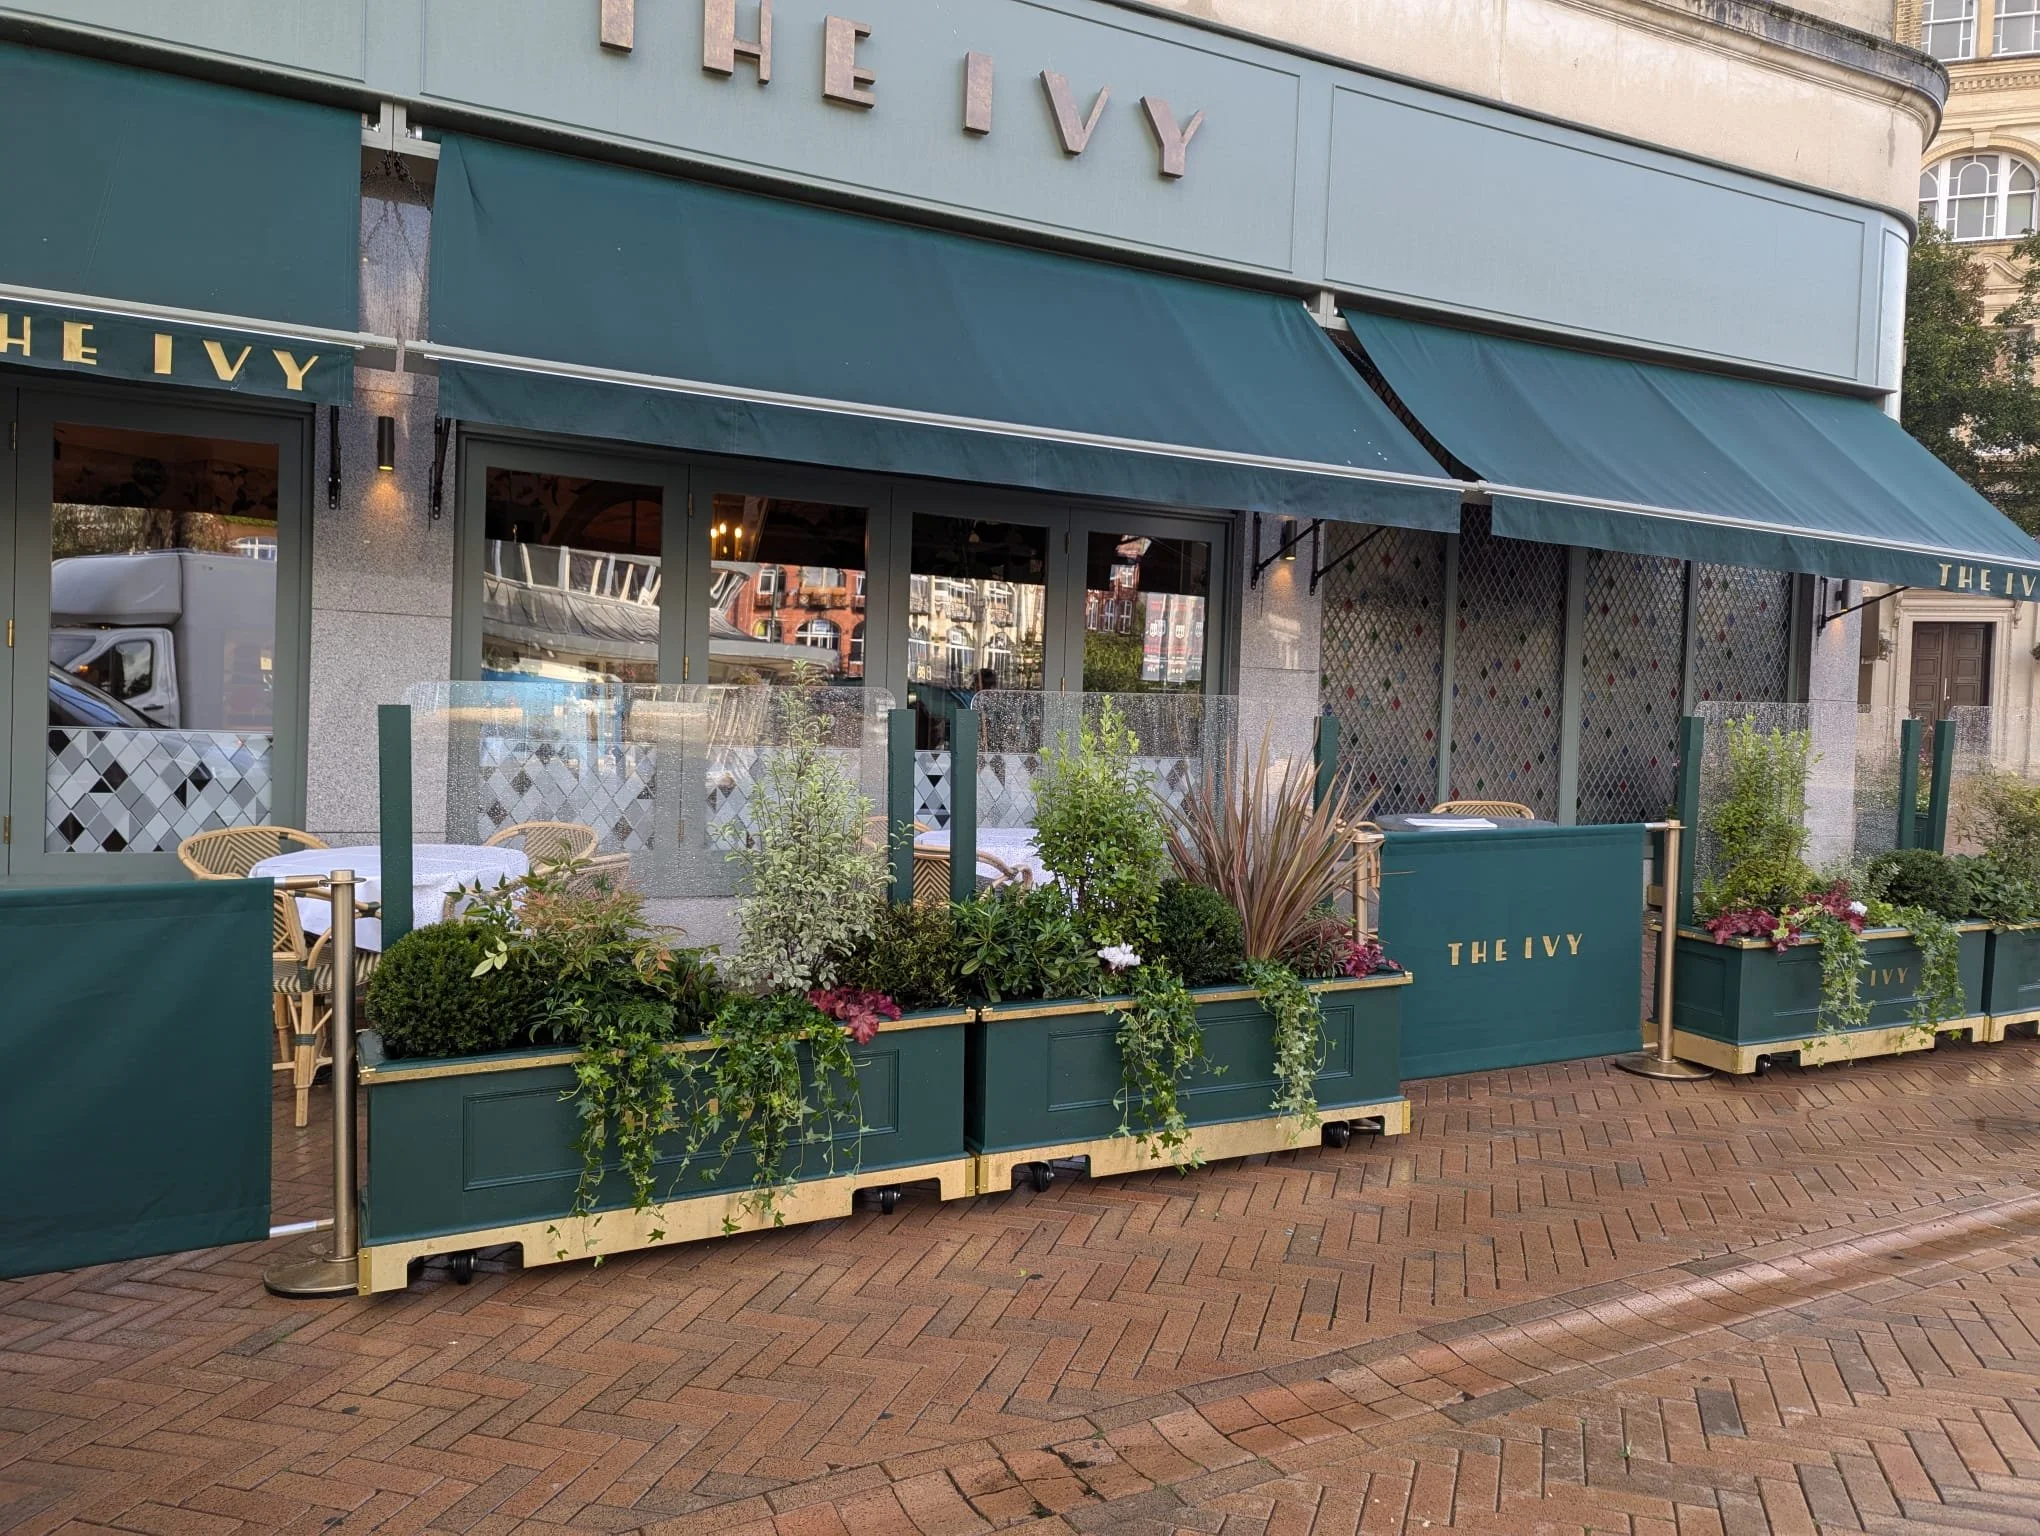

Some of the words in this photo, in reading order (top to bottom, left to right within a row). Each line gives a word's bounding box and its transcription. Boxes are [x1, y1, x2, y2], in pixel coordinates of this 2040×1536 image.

[962, 50, 1206, 179] IVY
[154, 333, 319, 391] IVY
[1939, 563, 1991, 592] THE
[1448, 939, 1507, 966] THE
[1524, 933, 1583, 959] IVY
[1870, 967, 1908, 987] IVY
